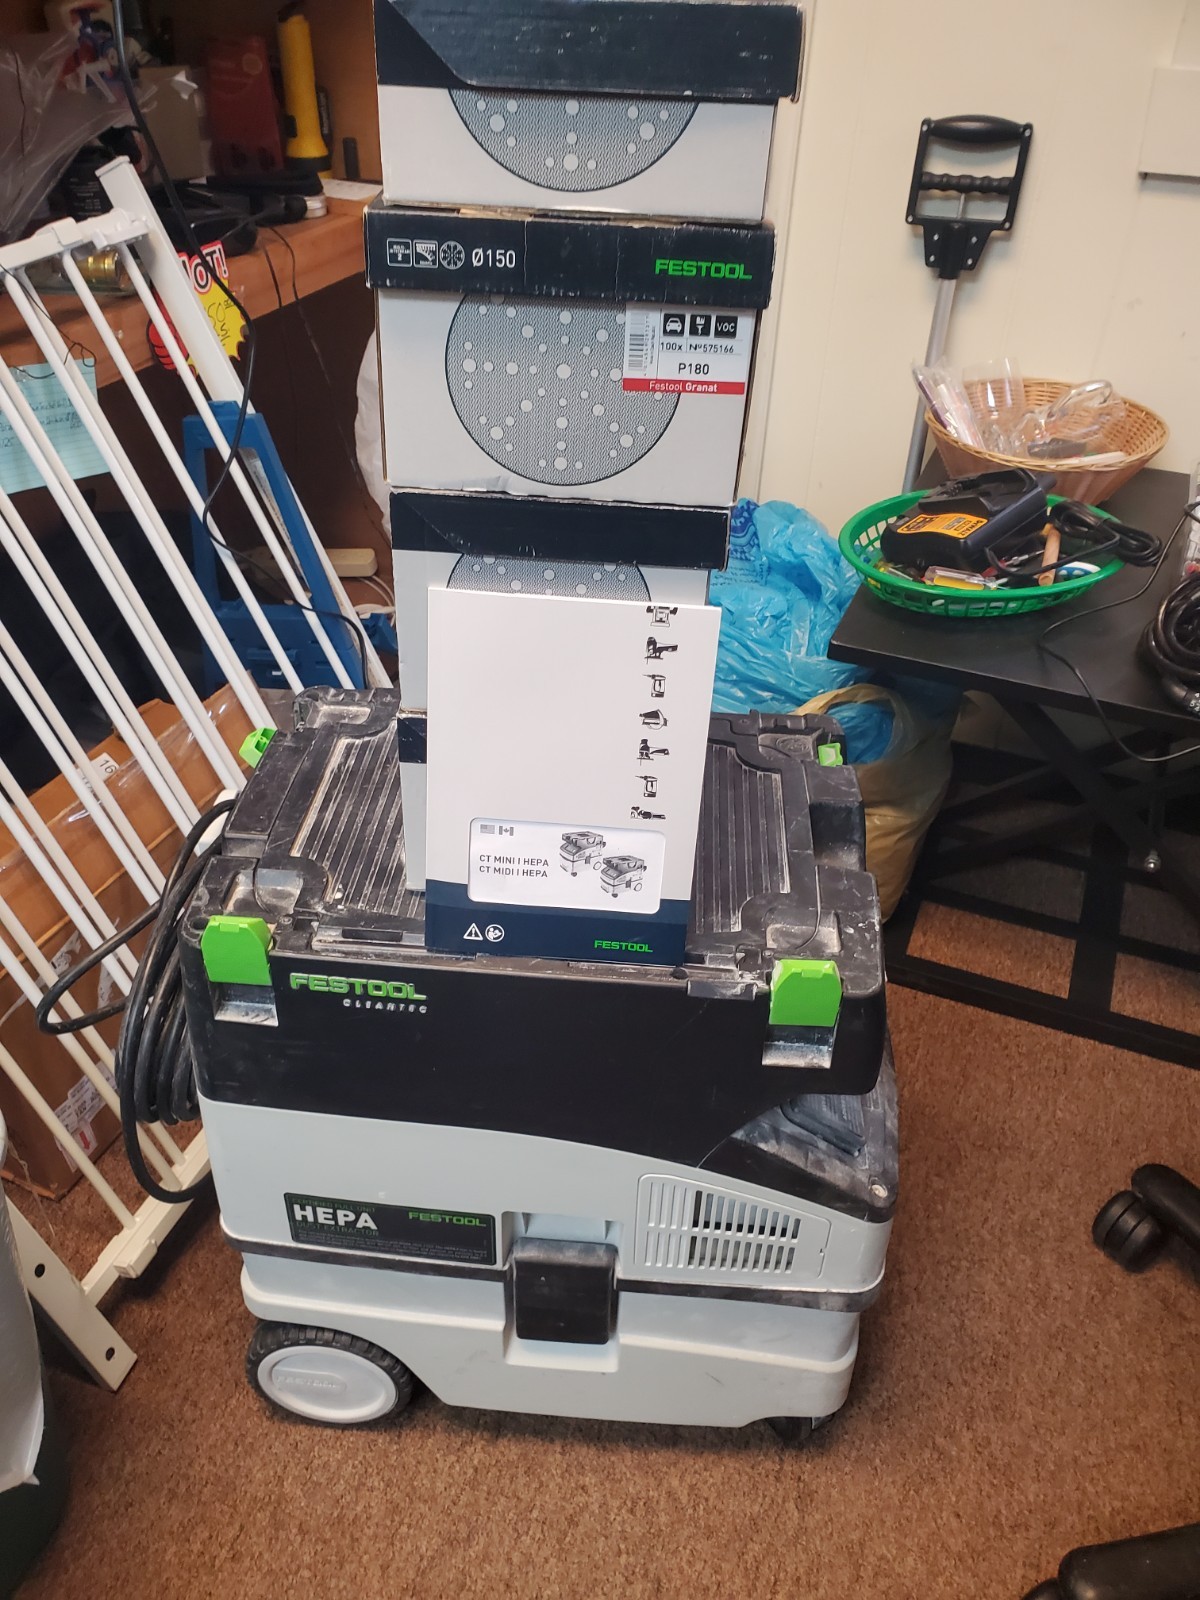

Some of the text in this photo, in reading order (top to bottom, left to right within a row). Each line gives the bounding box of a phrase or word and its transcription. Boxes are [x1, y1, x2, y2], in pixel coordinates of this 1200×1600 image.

[472, 248, 516, 268] Ø150
[655, 259, 752, 279] FESTOOL
[717, 322, 735, 332] VOC
[660, 342, 683, 351] 100x
[678, 363, 710, 375] P180
[649, 381, 718, 393] Festool Granat
[479, 854, 492, 862] CT
[493, 855, 515, 865] MINI
[523, 858, 549, 867] HEPA
[479, 865, 491, 873] CT
[493, 866, 514, 876] MIDI
[522, 868, 548, 878] HEPA
[594, 940, 654, 953] FESTOOL
[289, 972, 427, 1000] FESTOOL
[343, 998, 428, 1014] CLEANTEC
[293, 1203, 487, 1230] HEPA FESTOOL
